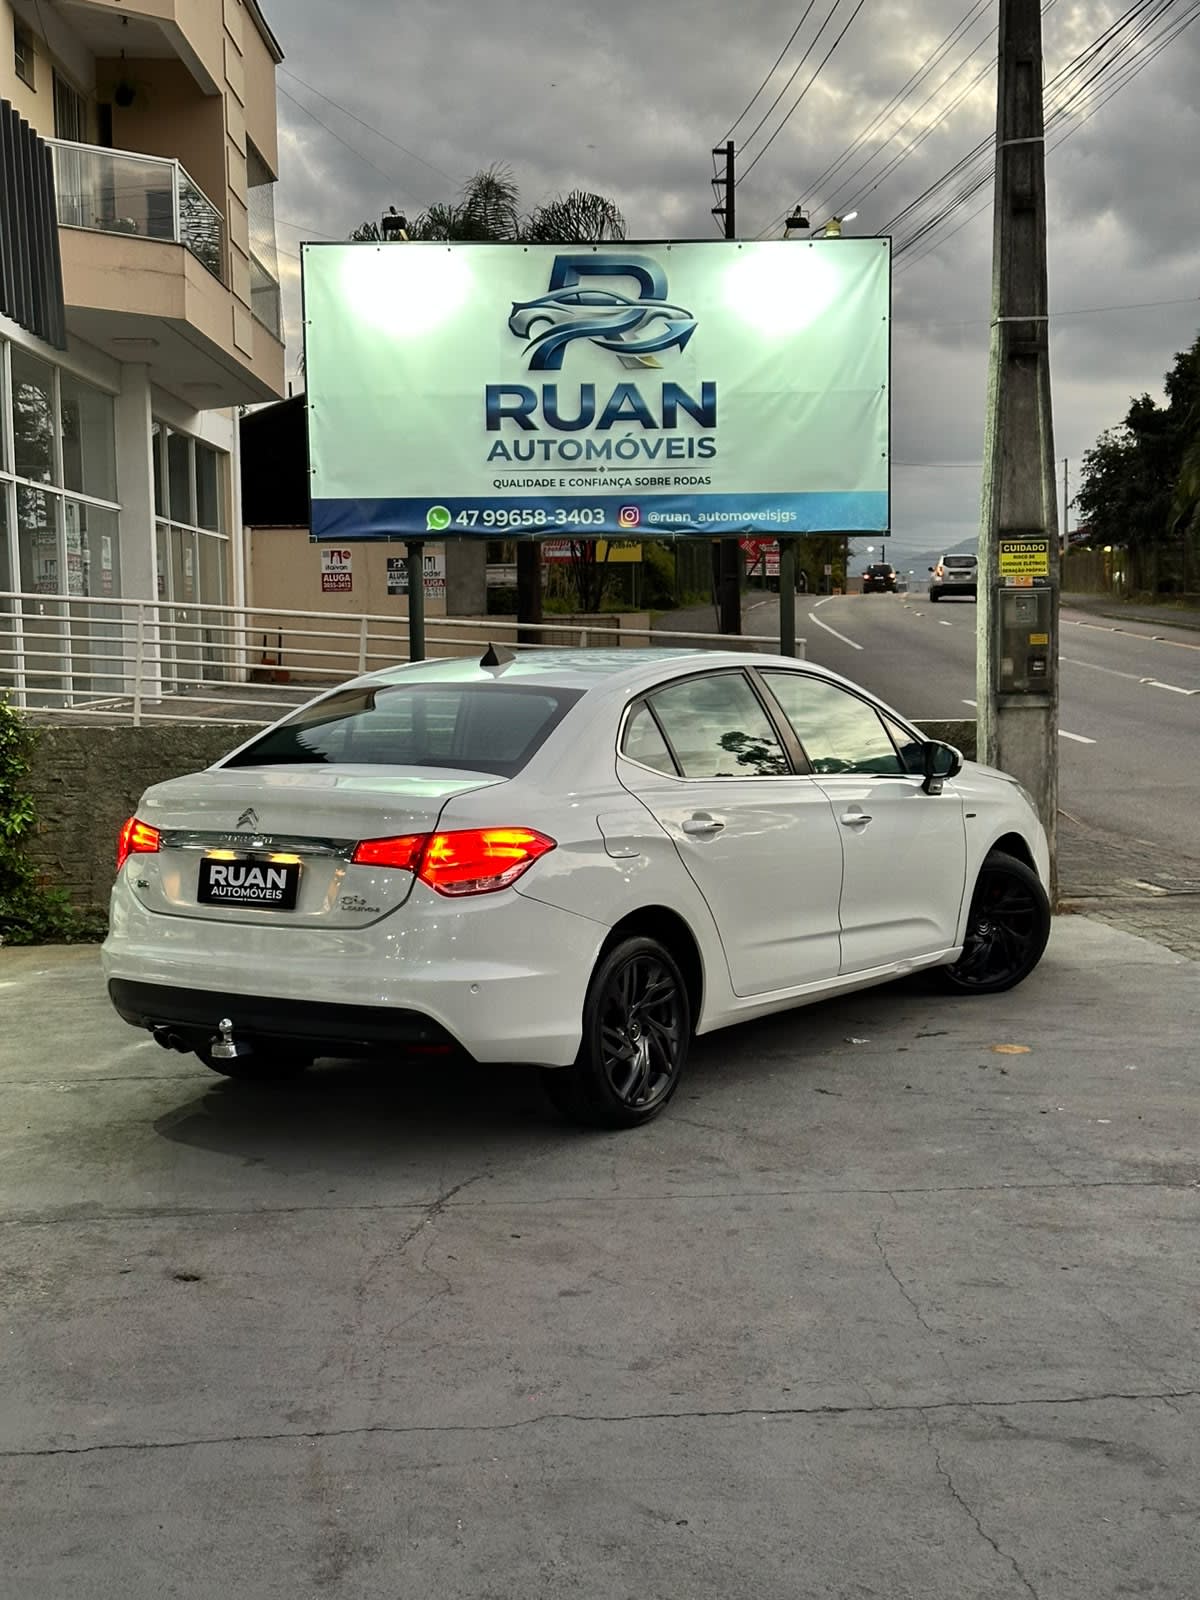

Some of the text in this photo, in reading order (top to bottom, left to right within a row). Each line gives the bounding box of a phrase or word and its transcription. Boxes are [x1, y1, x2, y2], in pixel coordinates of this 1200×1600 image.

[486, 381, 717, 432] RUAN
[487, 432, 717, 462] AUTOMÓVEIS
[493, 476, 712, 489] QUALIDADE E CONFIANÇA SOBRE RODAS
[456, 508, 606, 526] 47 99658-3403
[647, 508, 798, 524] @ruan_automoveisjgs
[1003, 544, 1045, 552] CUIDADO
[323, 573, 351, 582] ALUGA
[209, 865, 287, 889] RUAN
[211, 886, 283, 899] AUTOMÓVEIS
